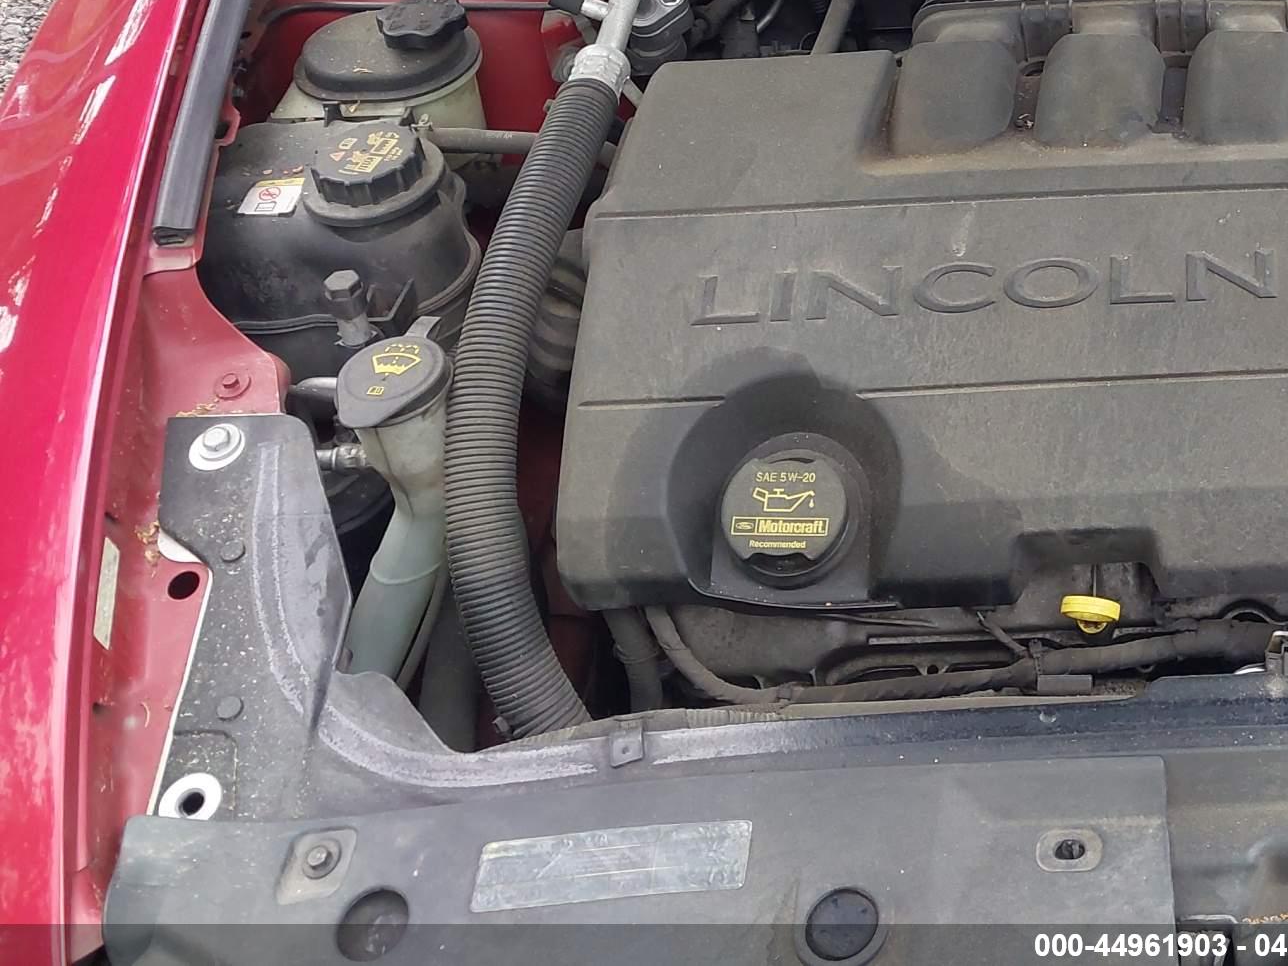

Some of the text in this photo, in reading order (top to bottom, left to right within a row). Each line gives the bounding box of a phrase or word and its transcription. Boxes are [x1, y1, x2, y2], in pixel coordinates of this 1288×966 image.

[691, 247, 1277, 326] LINCOLN
[755, 472, 816, 483] SAE 5W-20
[758, 520, 825, 533] Motorcraft
[749, 539, 807, 549] Recommended
